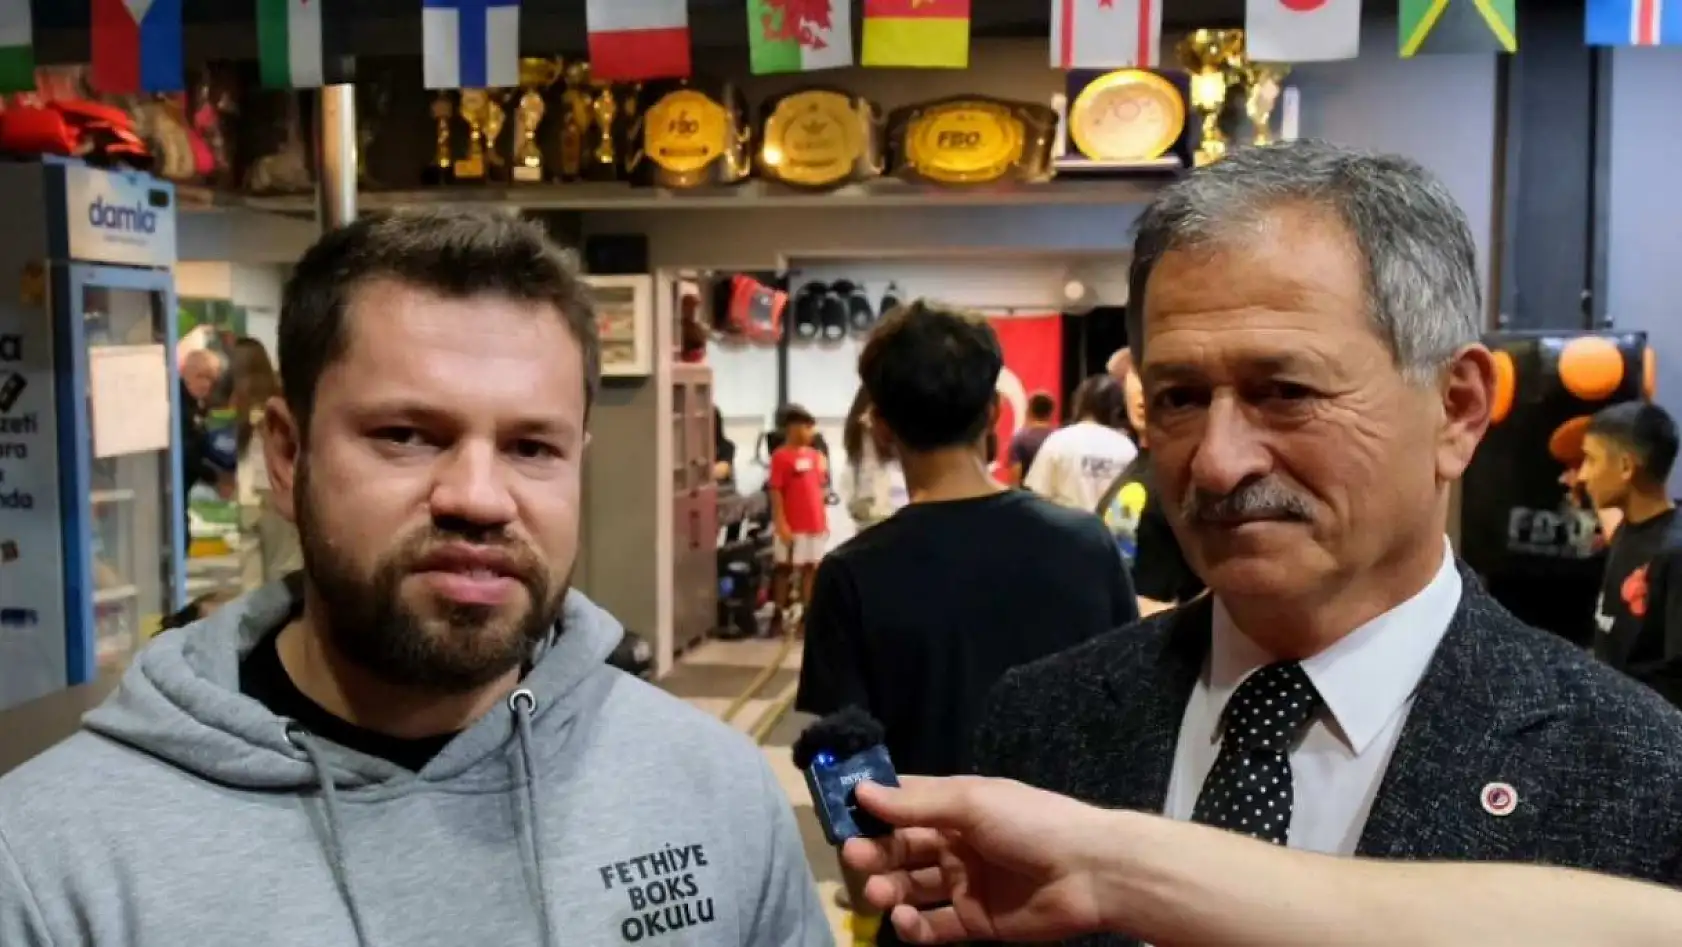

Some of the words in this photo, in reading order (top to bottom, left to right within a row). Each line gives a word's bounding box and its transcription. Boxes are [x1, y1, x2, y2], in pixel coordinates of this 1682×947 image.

[88, 194, 156, 234] damla
[599, 842, 708, 890] FETHİYE
[628, 873, 699, 911] BOKS
[621, 897, 715, 942] OKULU
